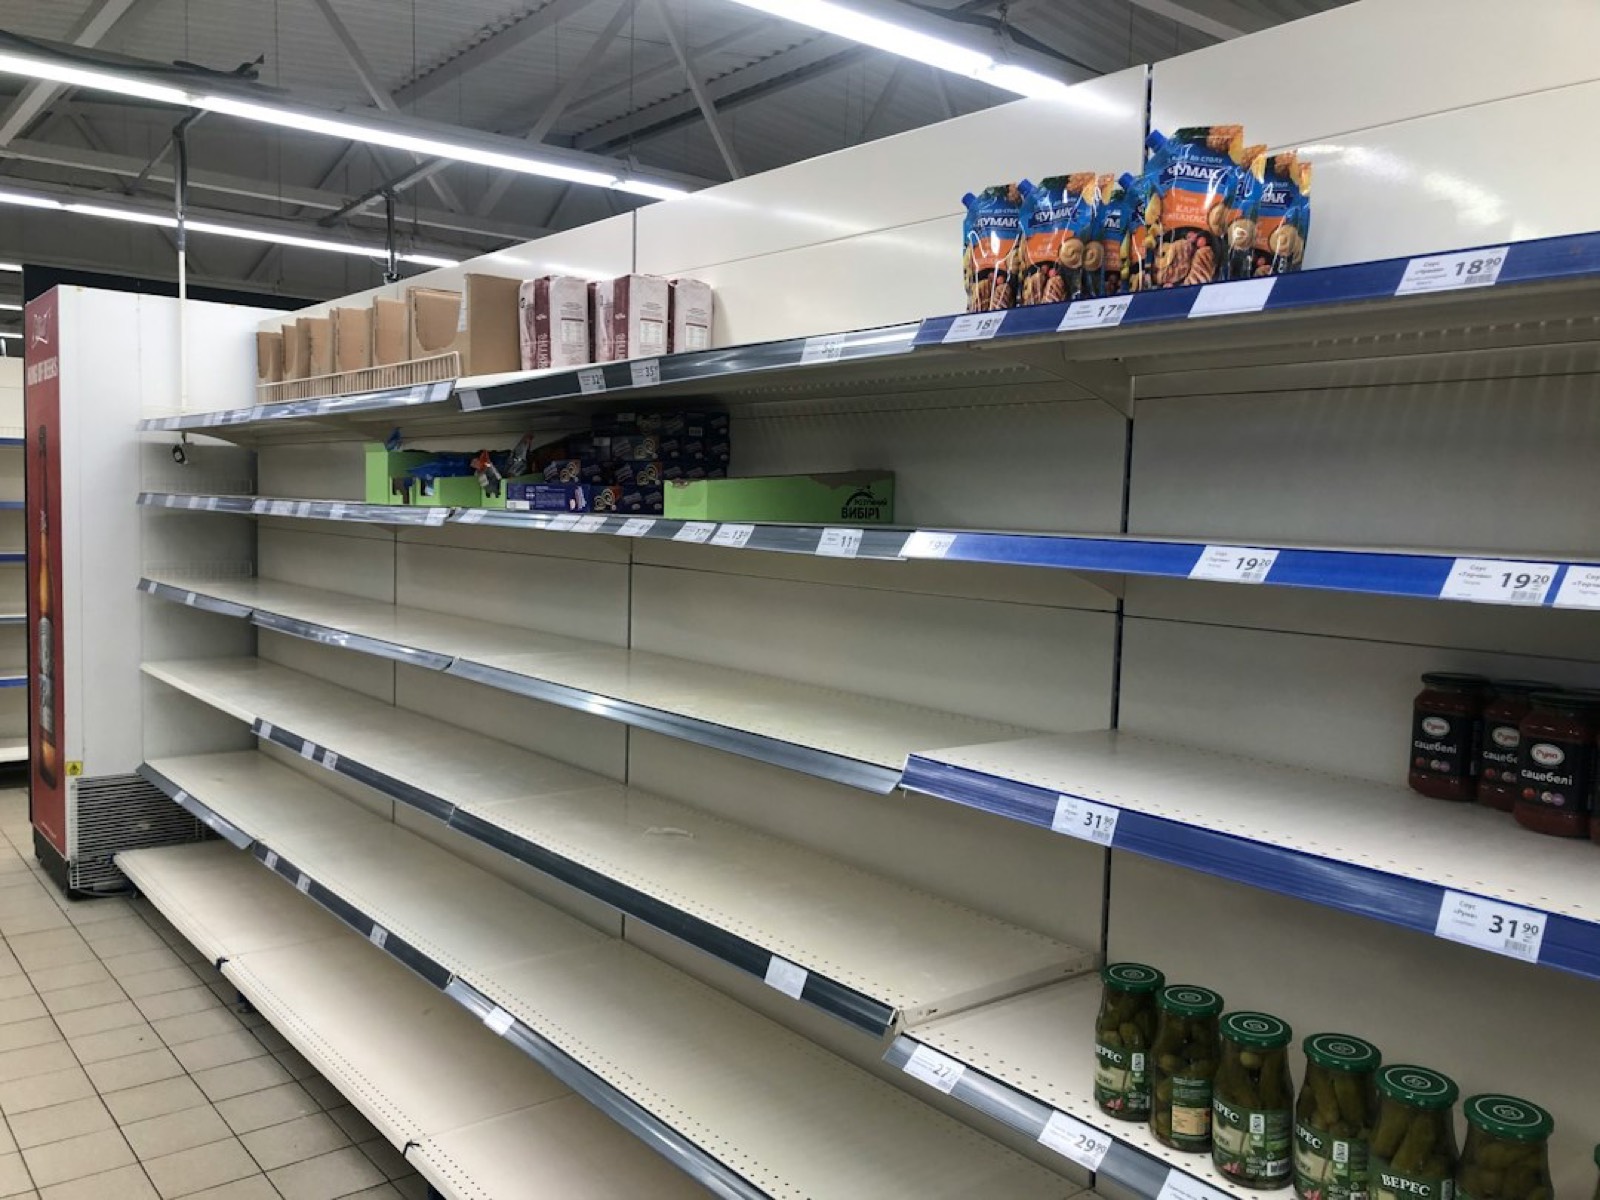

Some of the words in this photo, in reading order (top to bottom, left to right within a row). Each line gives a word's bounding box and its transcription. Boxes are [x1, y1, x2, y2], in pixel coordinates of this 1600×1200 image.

[1167, 163, 1220, 179] ЧУМАК
[1035, 207, 1073, 222] ЧУМАК
[978, 217, 1018, 228] ЧУМАК
[1414, 740, 1456, 755] сацебелі
[1482, 750, 1518, 765] сацеб
[1521, 769, 1573, 786] сацебелі
[1096, 1044, 1123, 1063] ЕРЕС
[1381, 1172, 1431, 1197] ВЕРЕС
